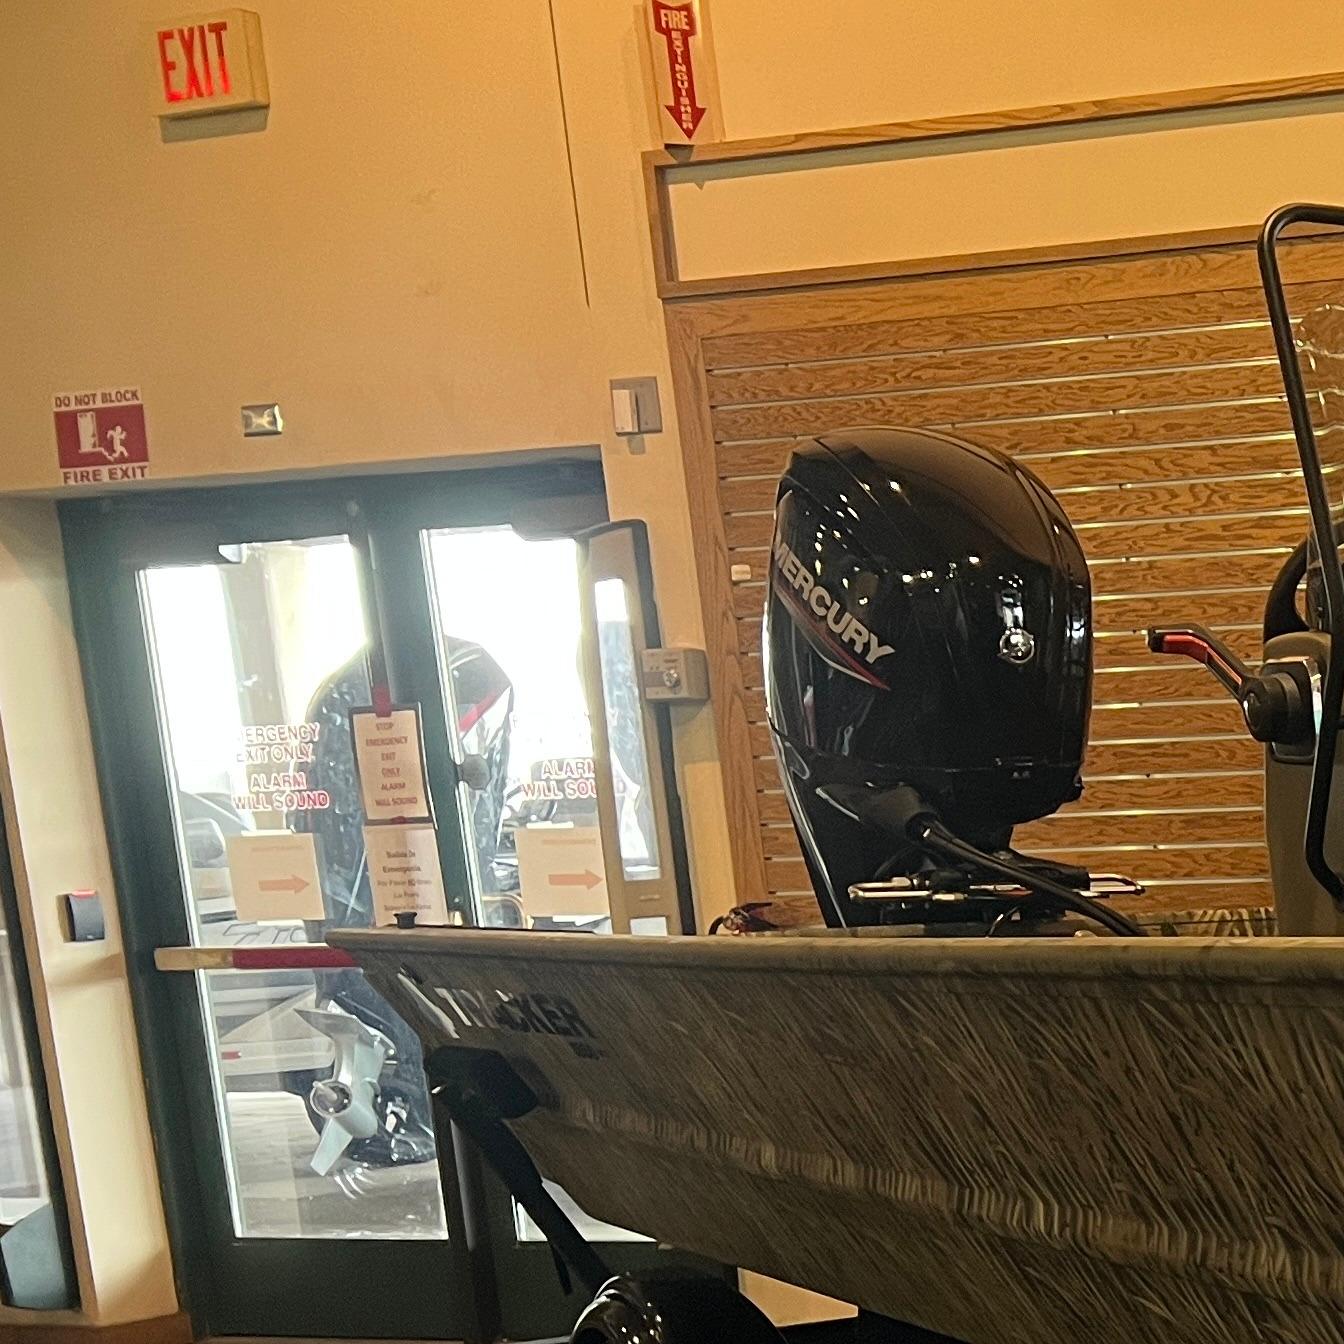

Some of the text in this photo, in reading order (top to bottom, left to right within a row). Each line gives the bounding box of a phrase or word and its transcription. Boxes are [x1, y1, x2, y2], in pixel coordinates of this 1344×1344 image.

[660, 9, 690, 30] FIRE
[157, 21, 231, 103] EXIT
[671, 30, 693, 130] EXTINGUISHER
[55, 389, 139, 408] DO NOT BLOCK
[63, 465, 148, 484] FIRE EXIT
[774, 541, 896, 664] MERCURY
[250, 772, 307, 792] ALARM
[521, 781, 563, 801] WILL
[233, 790, 330, 812] WILL SOUND
